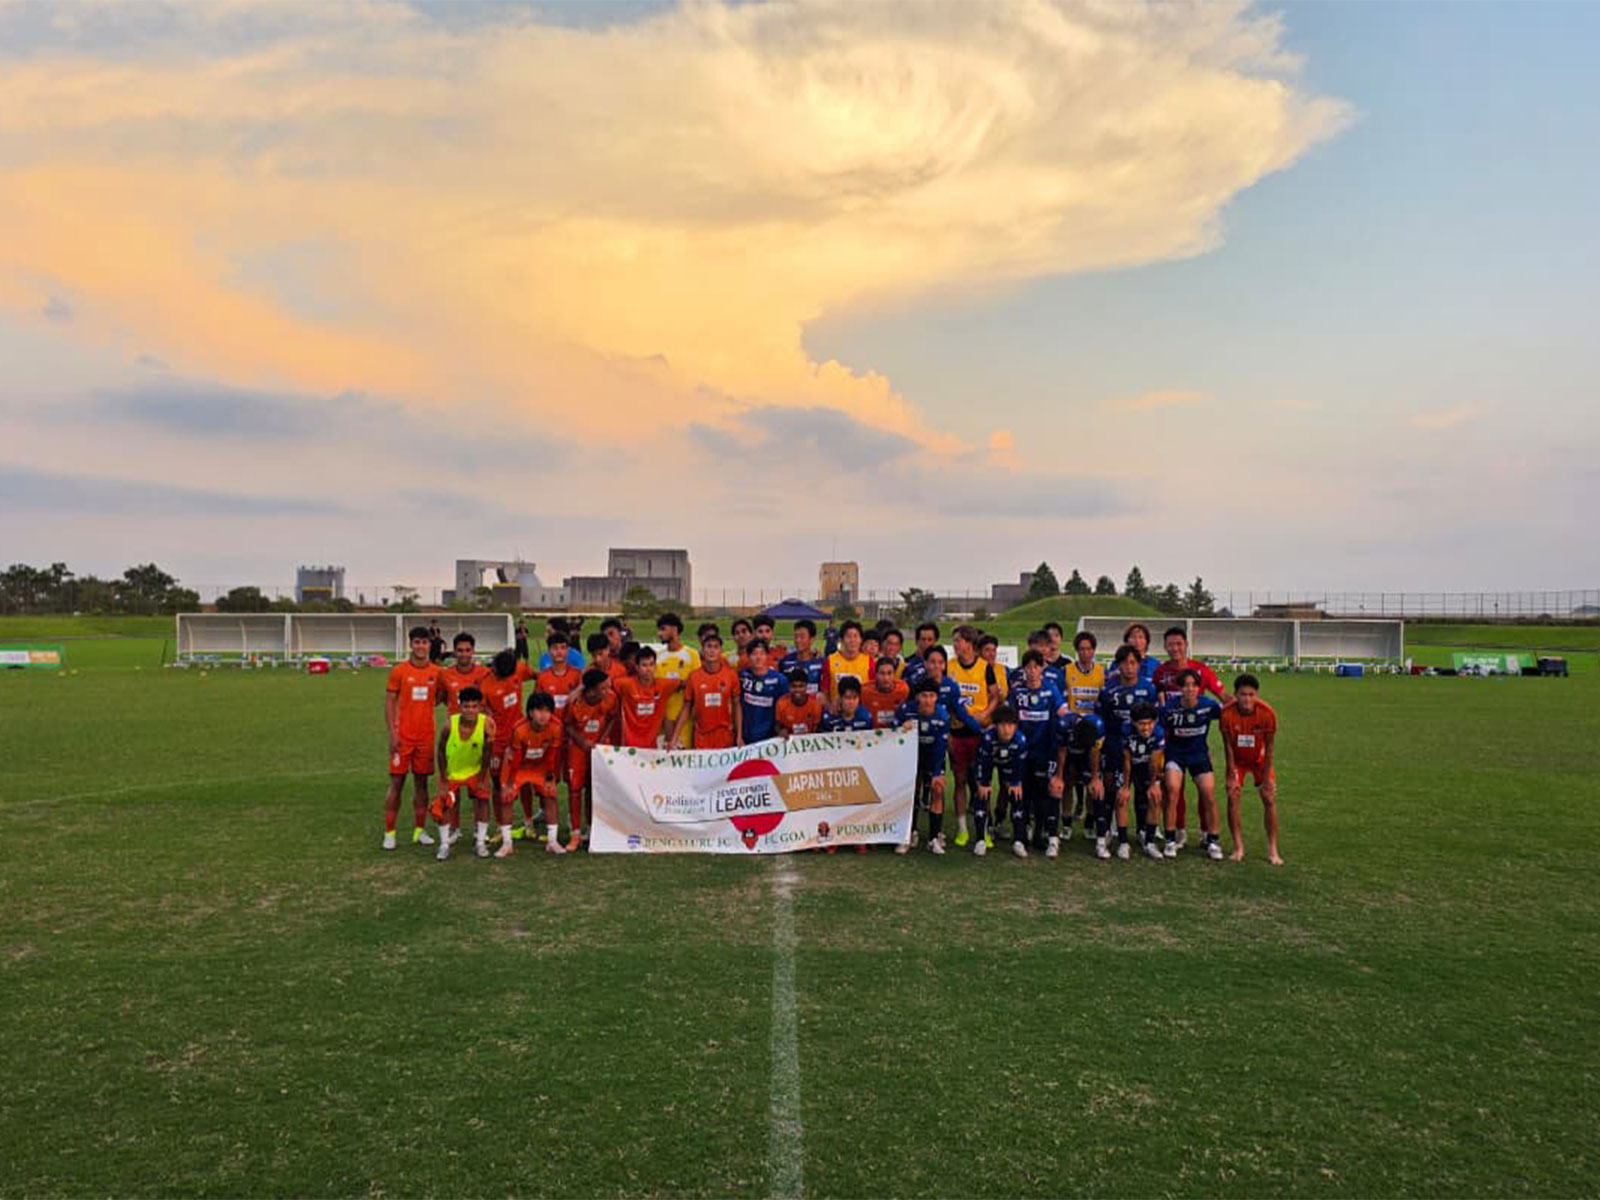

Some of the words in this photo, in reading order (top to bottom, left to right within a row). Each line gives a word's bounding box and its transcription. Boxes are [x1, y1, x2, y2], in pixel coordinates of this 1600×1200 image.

[670, 748, 754, 769] WELCOME
[758, 743, 778, 760] TO
[781, 735, 842, 759] JAPAN!
[786, 773, 825, 794] JAPAN
[827, 768, 860, 788] TOUR
[715, 793, 771, 813] LEAGUE
[780, 831, 805, 842] GOA
[836, 823, 881, 836] PUNJAB
